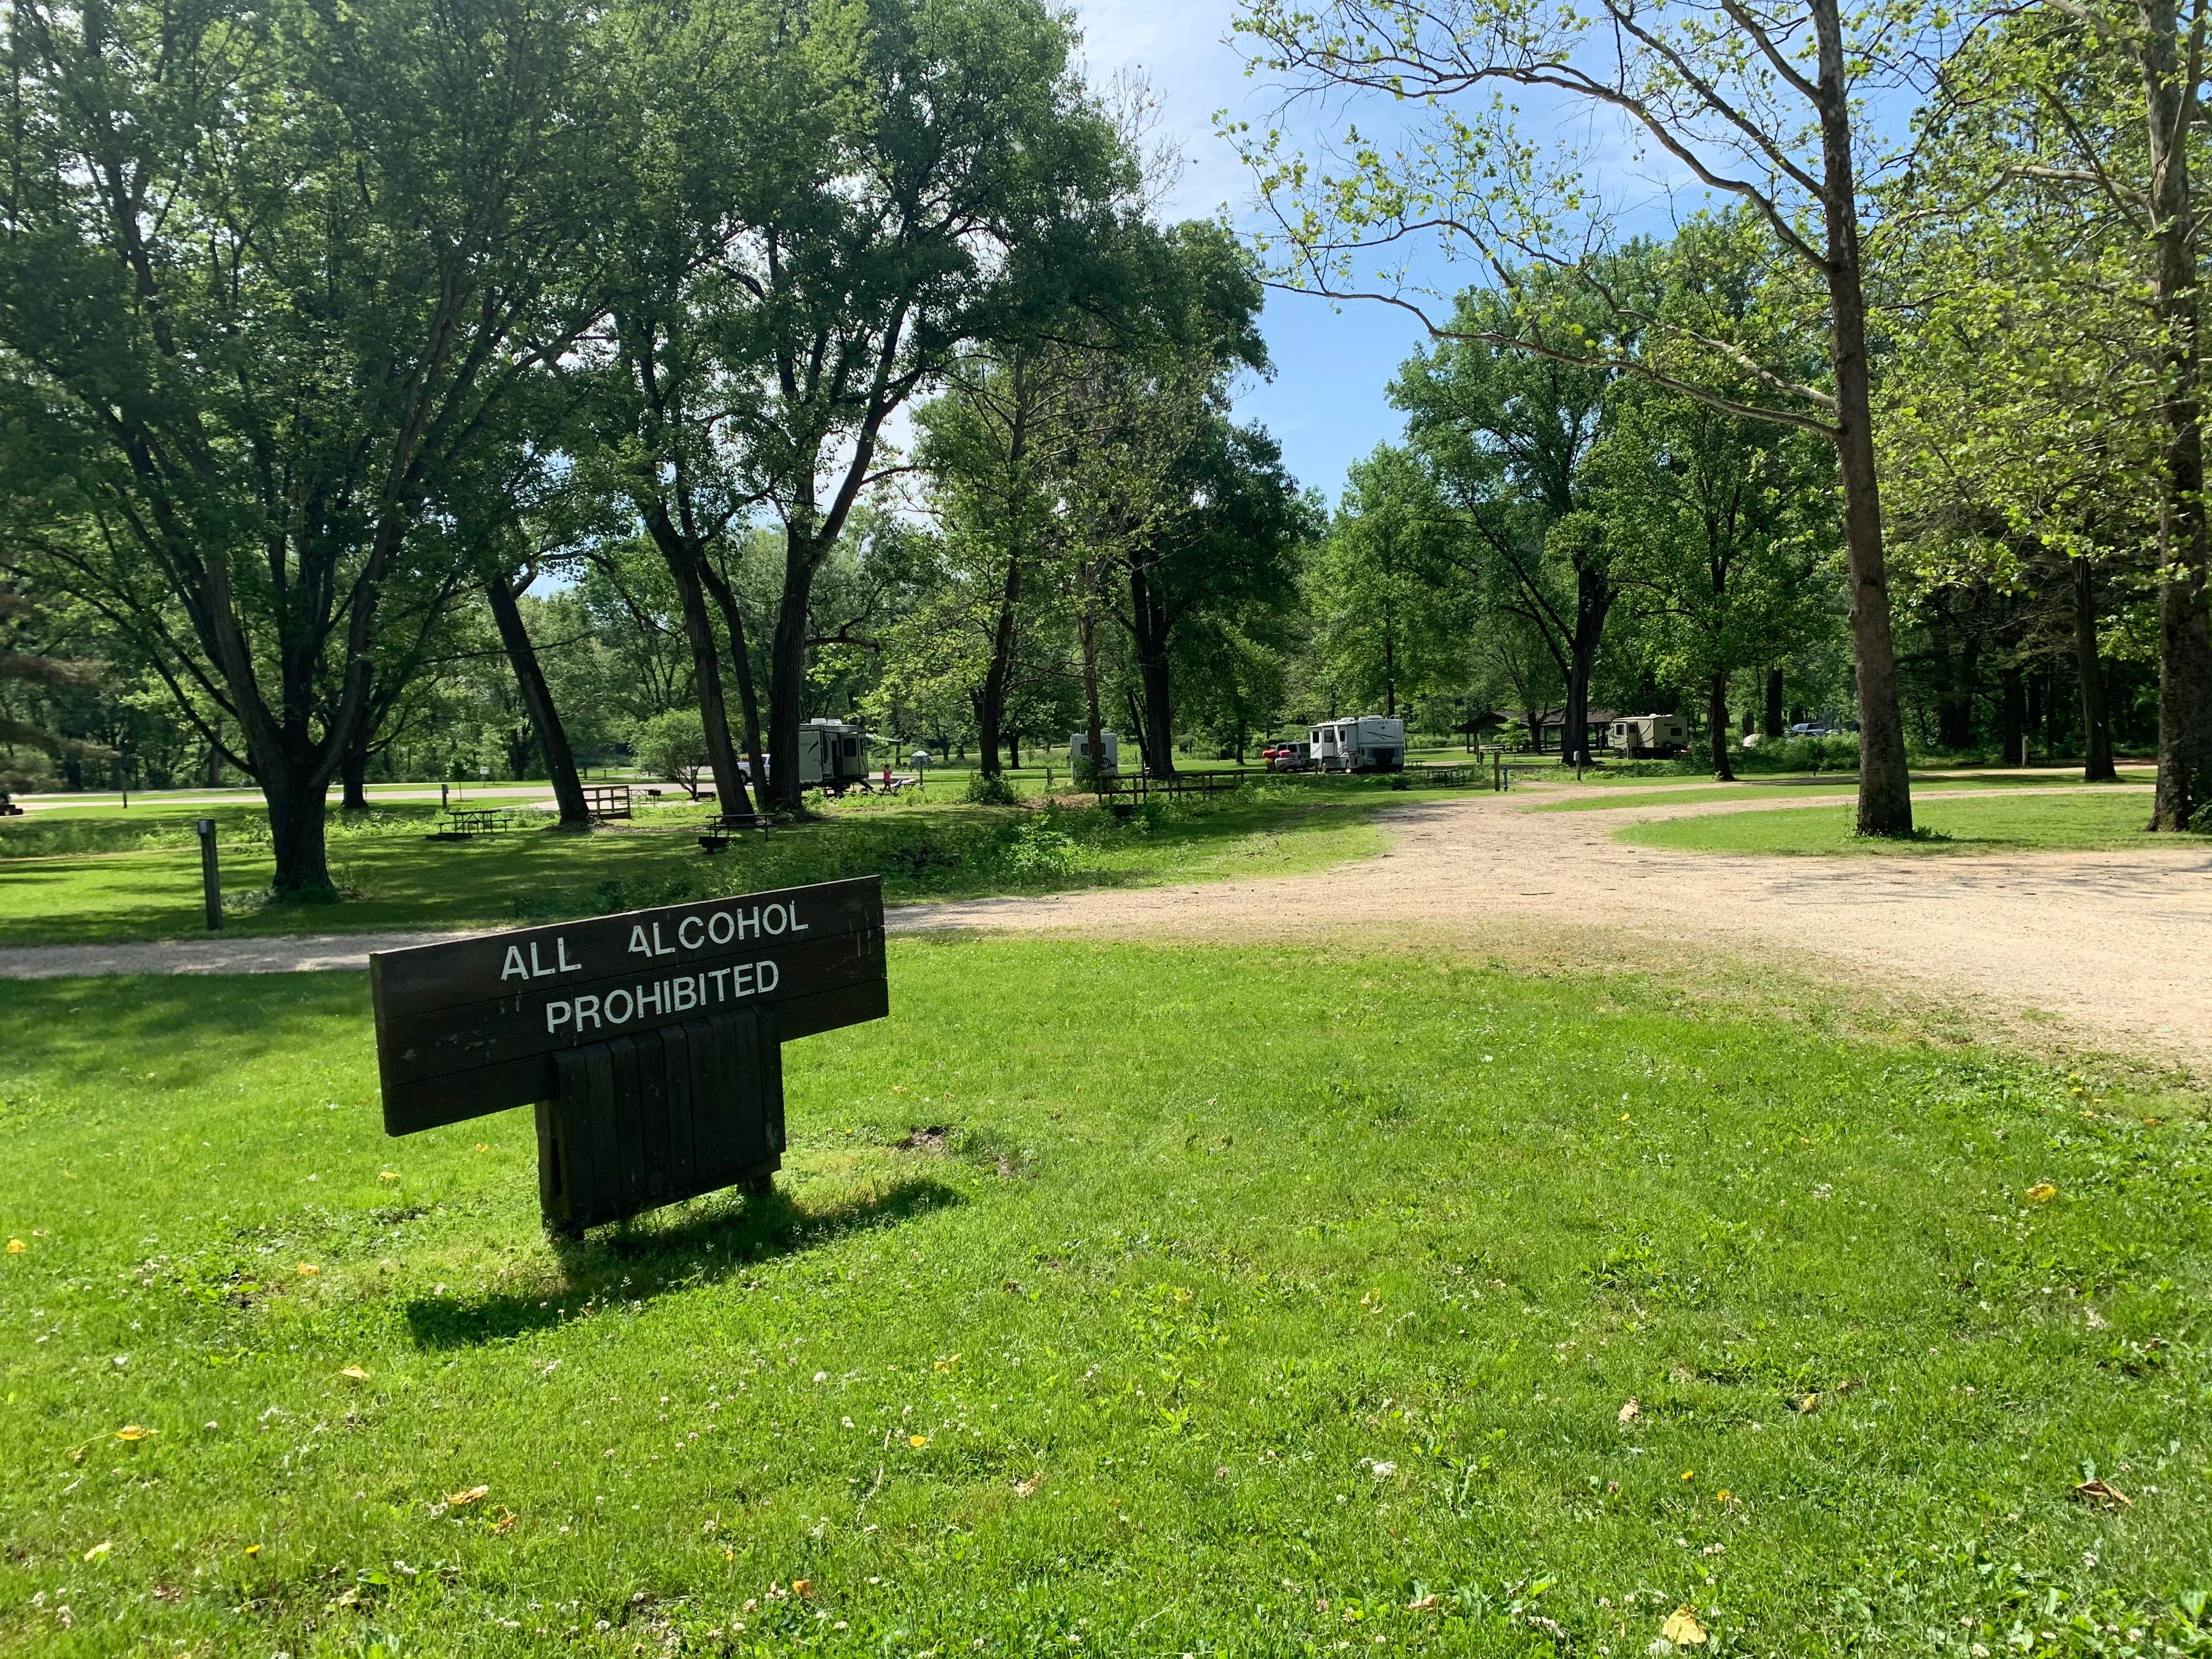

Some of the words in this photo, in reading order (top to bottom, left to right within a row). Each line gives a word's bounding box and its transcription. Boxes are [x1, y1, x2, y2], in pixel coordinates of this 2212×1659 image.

[501, 938, 582, 981] ALL
[628, 900, 808, 957] ALCOHOL
[546, 961, 778, 1034] PROHIBITED
